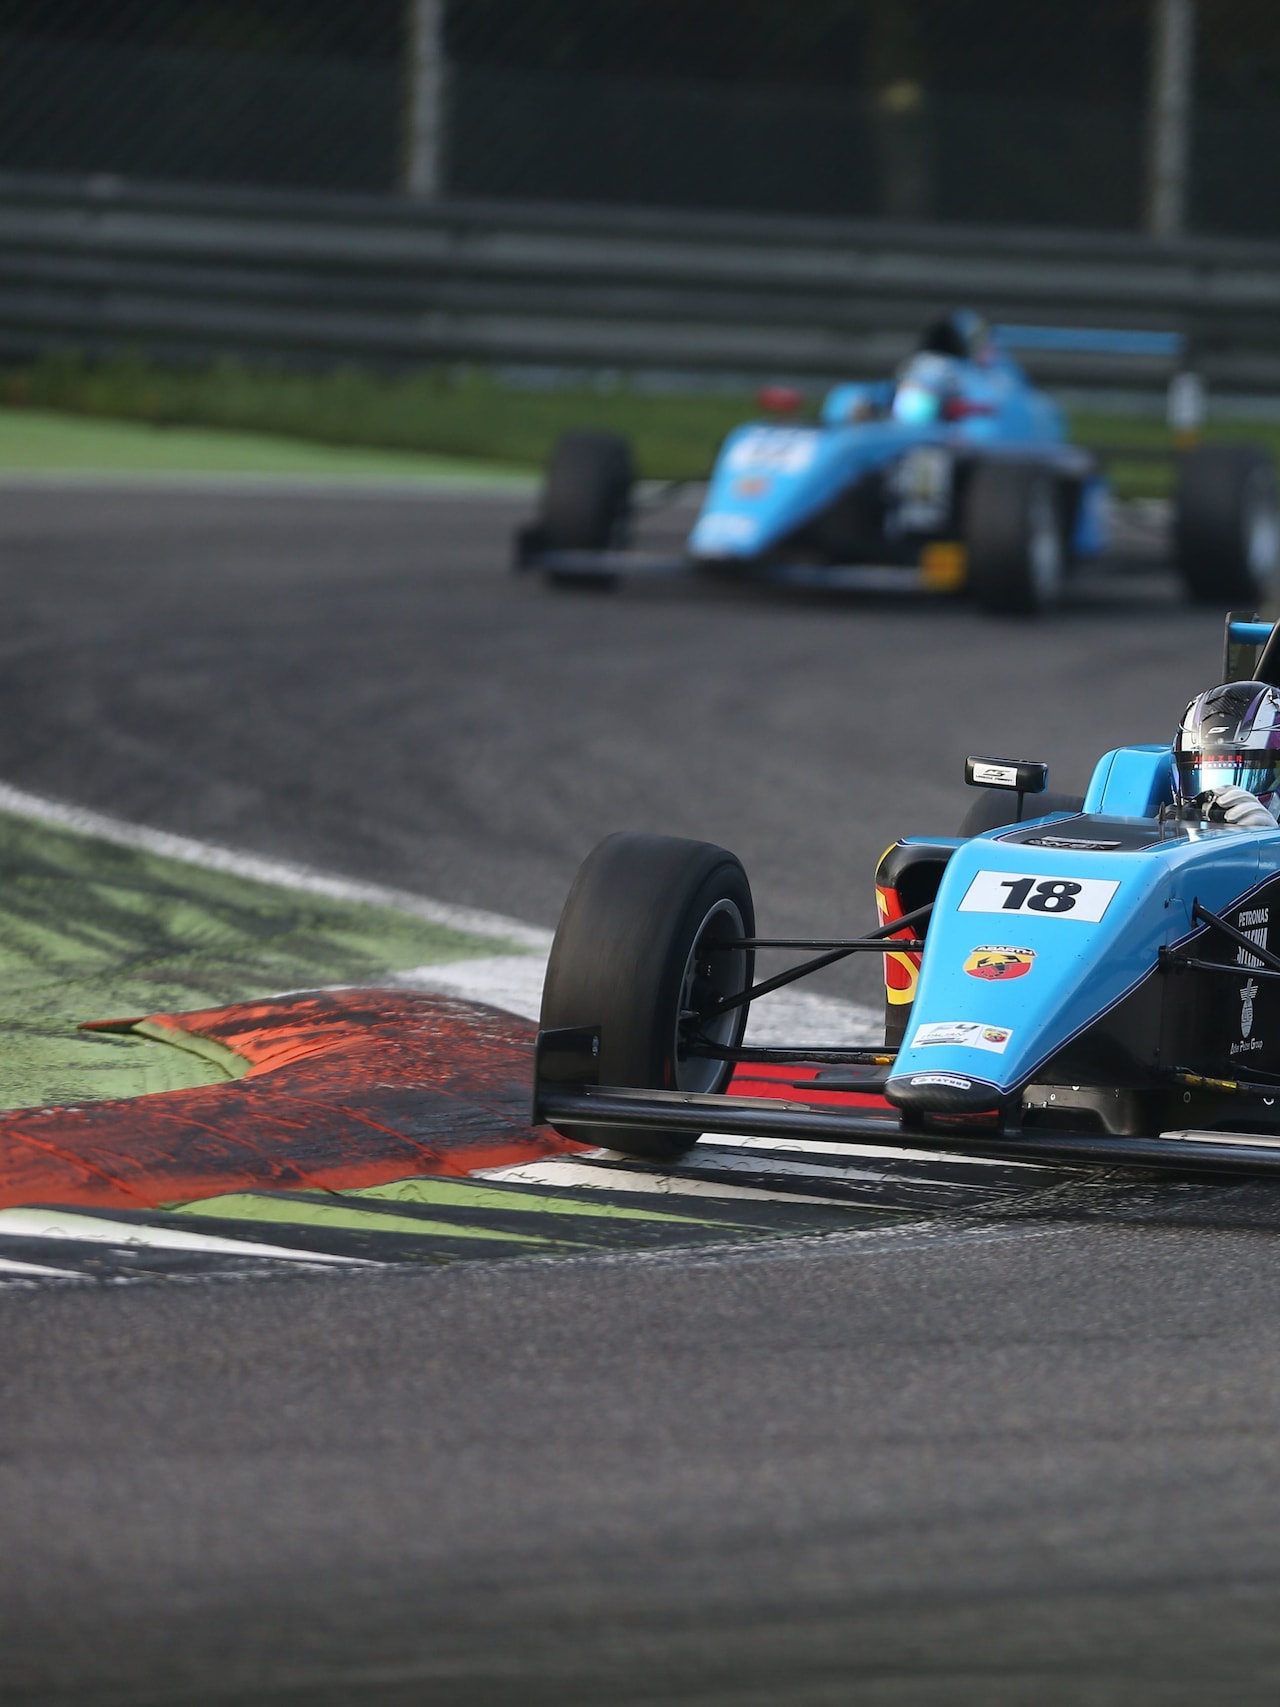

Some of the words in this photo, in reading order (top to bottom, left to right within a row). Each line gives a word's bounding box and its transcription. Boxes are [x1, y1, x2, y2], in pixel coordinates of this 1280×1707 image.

[1001, 878, 1081, 912] 18
[1238, 908, 1269, 927] PETRONAS
[977, 946, 1034, 955] ABARTH
